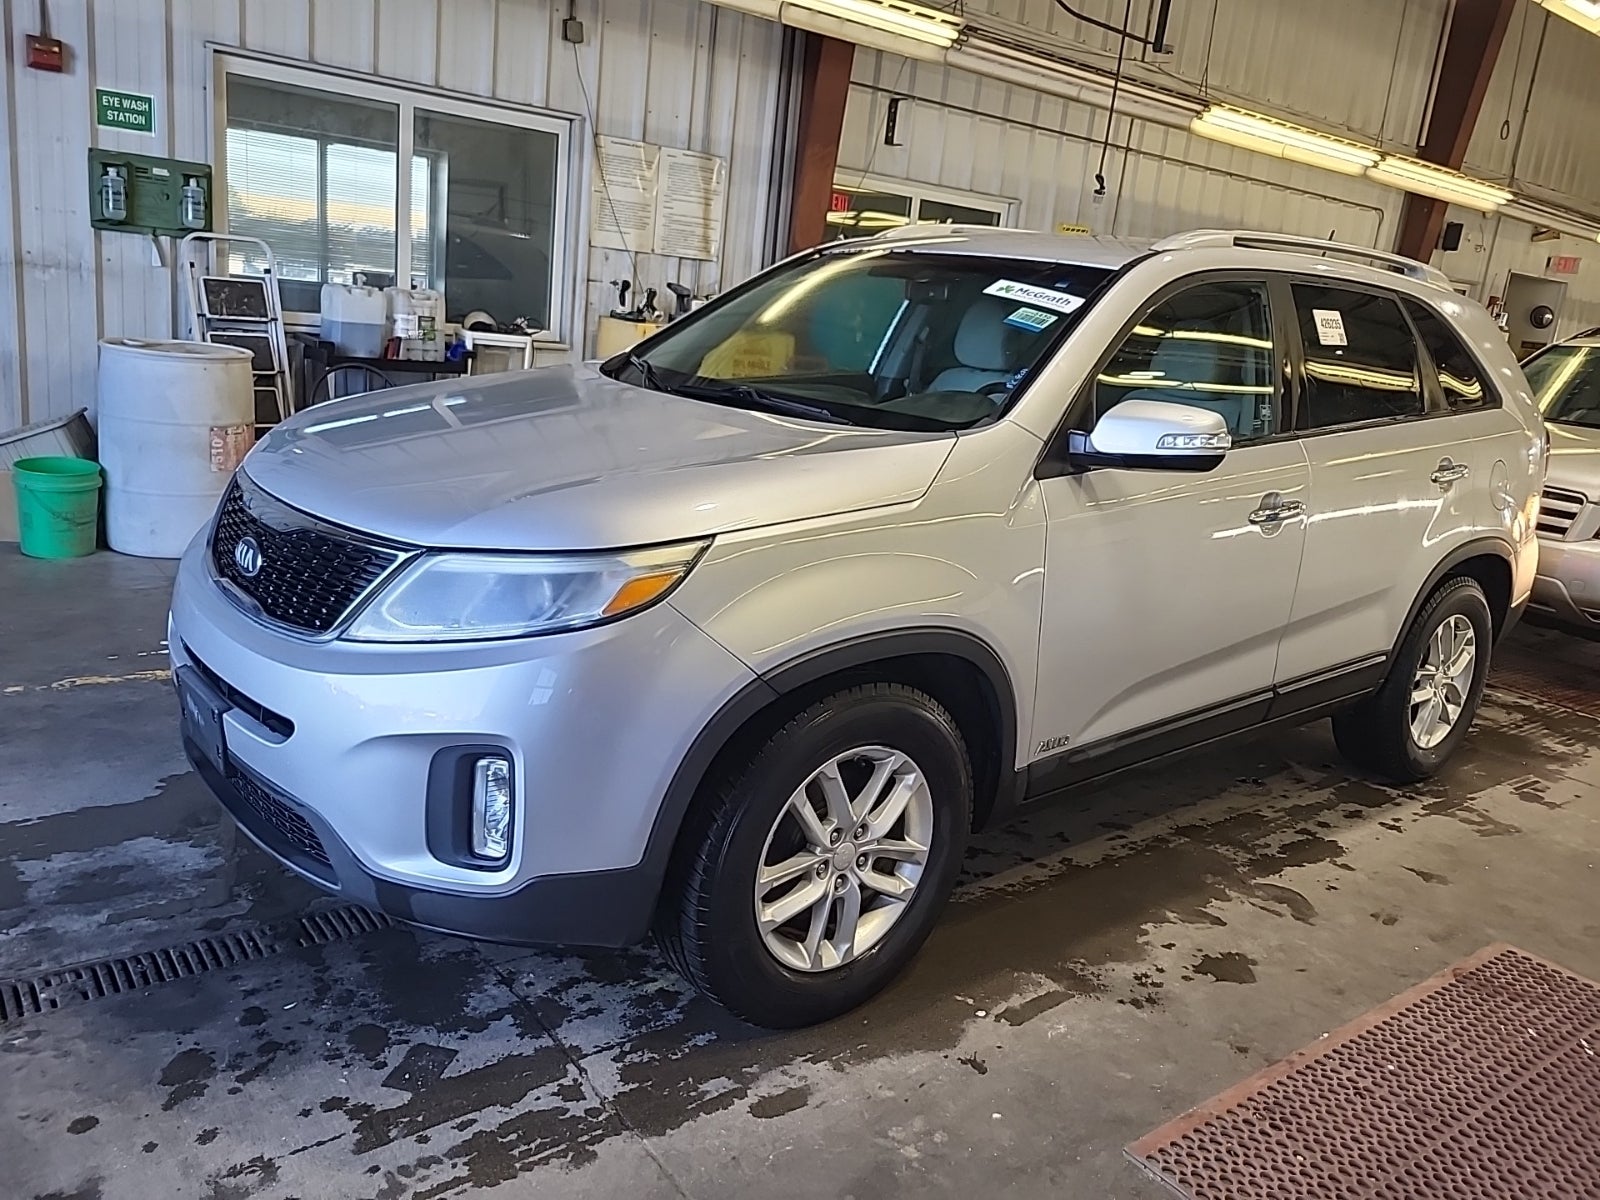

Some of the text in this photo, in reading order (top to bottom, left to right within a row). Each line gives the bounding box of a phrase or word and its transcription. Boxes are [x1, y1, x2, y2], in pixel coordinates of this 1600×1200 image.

[102, 95, 149, 112] EYE WASH
[107, 110, 146, 126] STATION
[1014, 287, 1072, 306] McGrath
[238, 541, 254, 572] KIA
